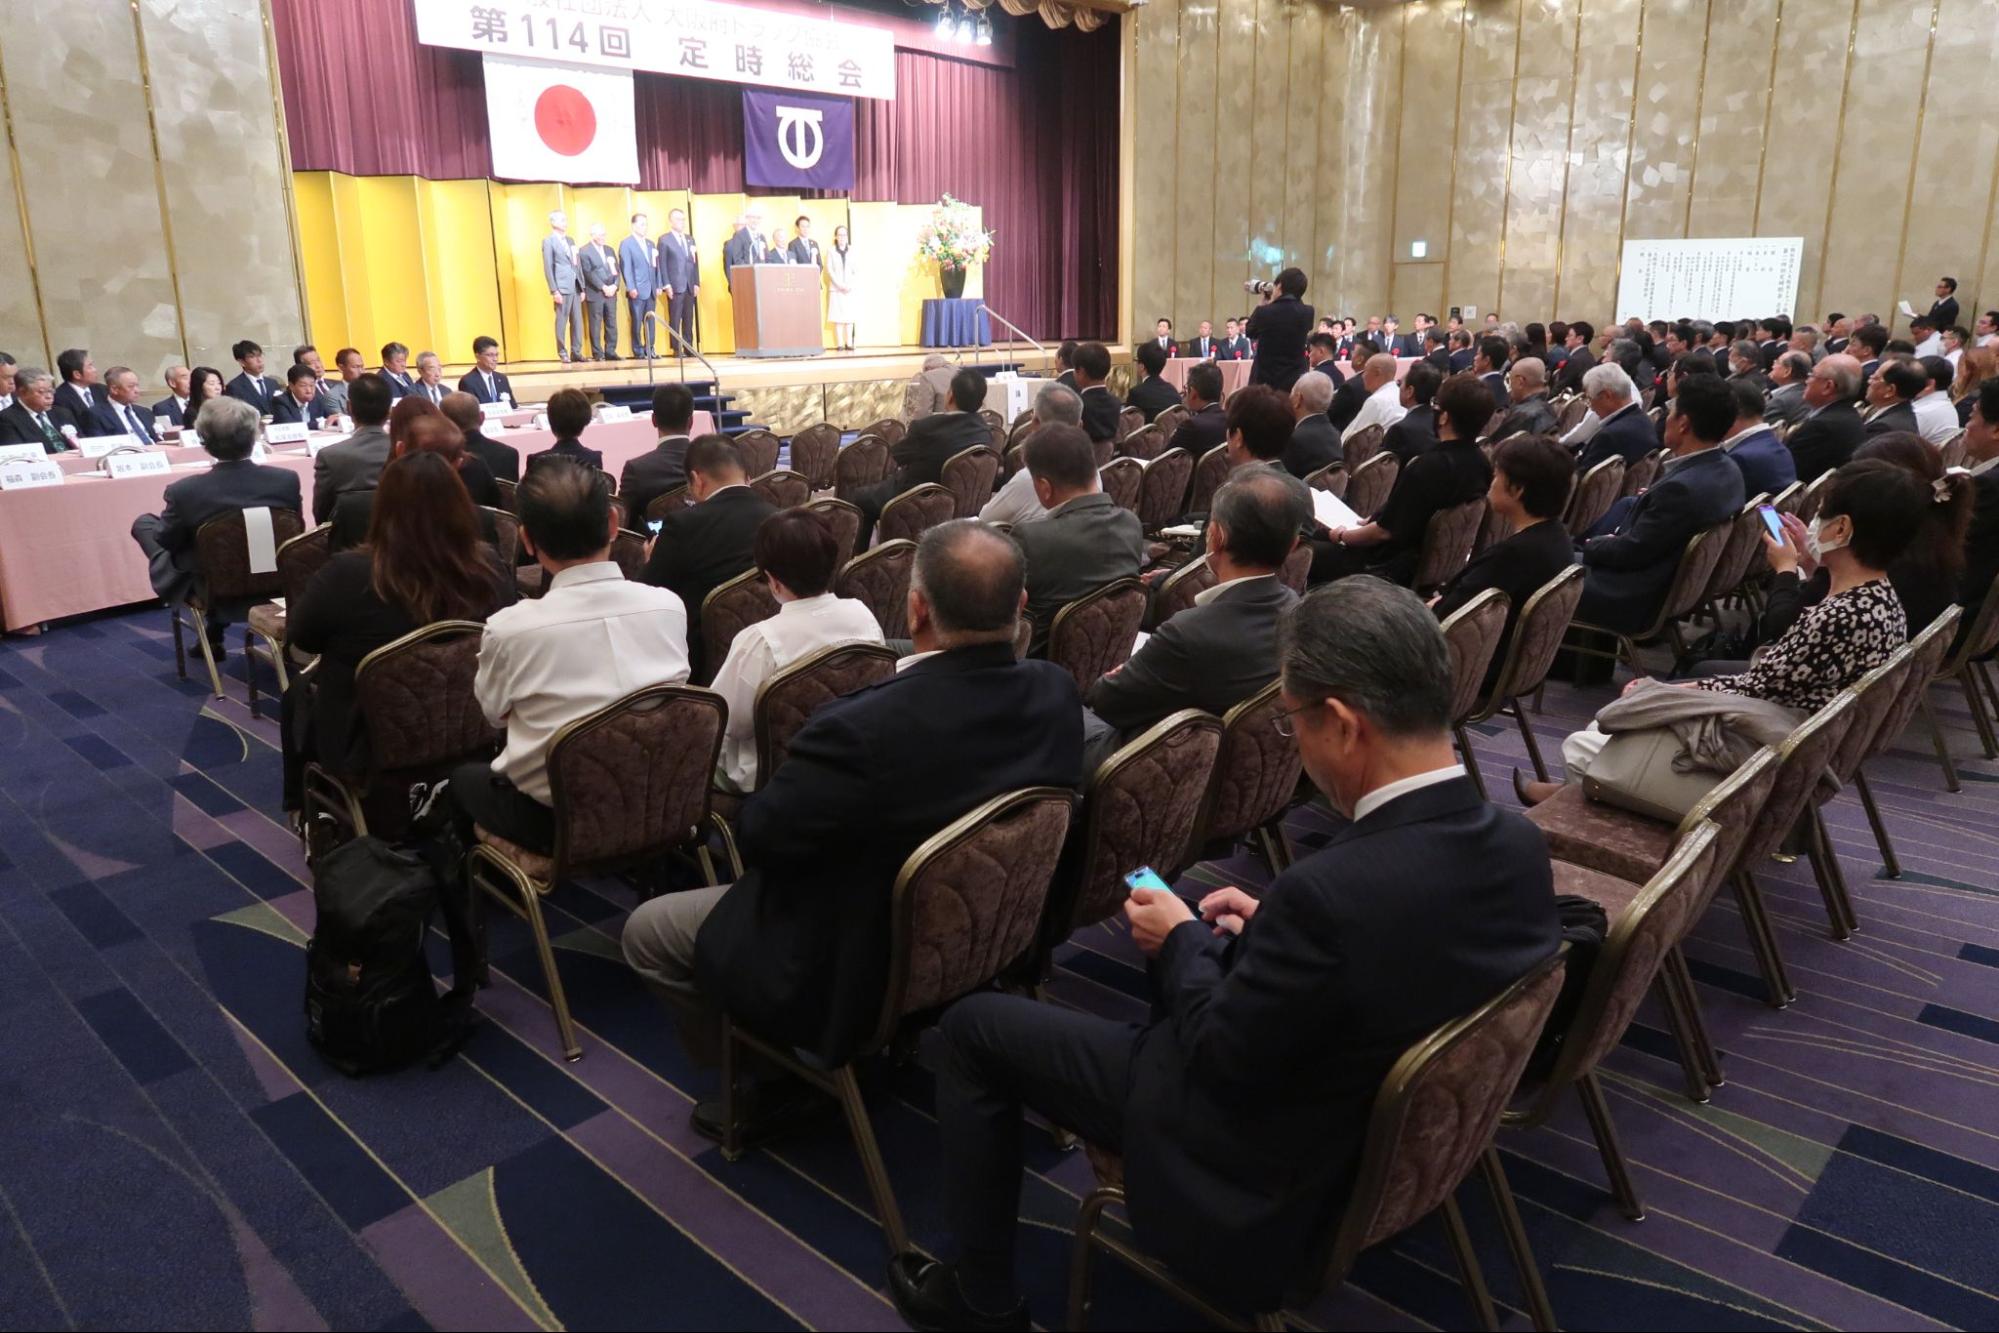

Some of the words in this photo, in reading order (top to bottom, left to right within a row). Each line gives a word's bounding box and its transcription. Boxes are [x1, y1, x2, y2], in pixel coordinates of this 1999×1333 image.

[470, 5, 632, 59] 第114回
[678, 36, 863, 89] 定時総会
